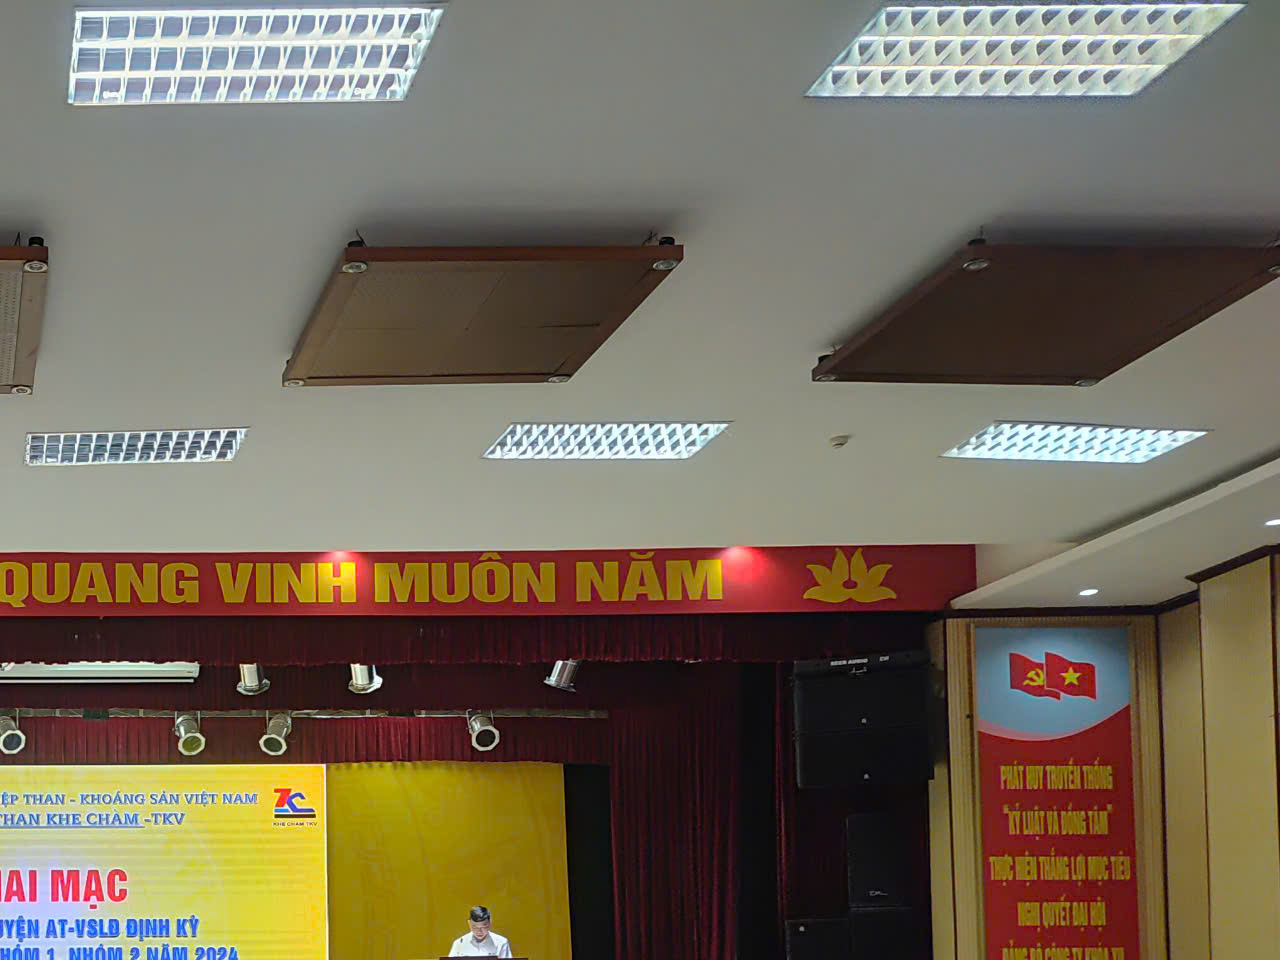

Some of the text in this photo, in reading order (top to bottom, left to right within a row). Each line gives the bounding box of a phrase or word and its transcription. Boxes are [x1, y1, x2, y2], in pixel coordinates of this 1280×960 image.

[215, 561, 357, 603] VINH
[374, 551, 556, 603] MUÔN
[575, 551, 723, 602] NĂM
[23, 794, 65, 805] THAN
[80, 790, 145, 805] KHOÁNG
[184, 790, 218, 807] VIỆT
[222, 794, 258, 804] NAM
[46, 813, 81, 825] KHE
[86, 809, 138, 825] CHÀM
[50, 868, 128, 910] MẠC
[45, 918, 120, 938] AT-VSLĐ
[126, 918, 170, 942] ĐỊNH
